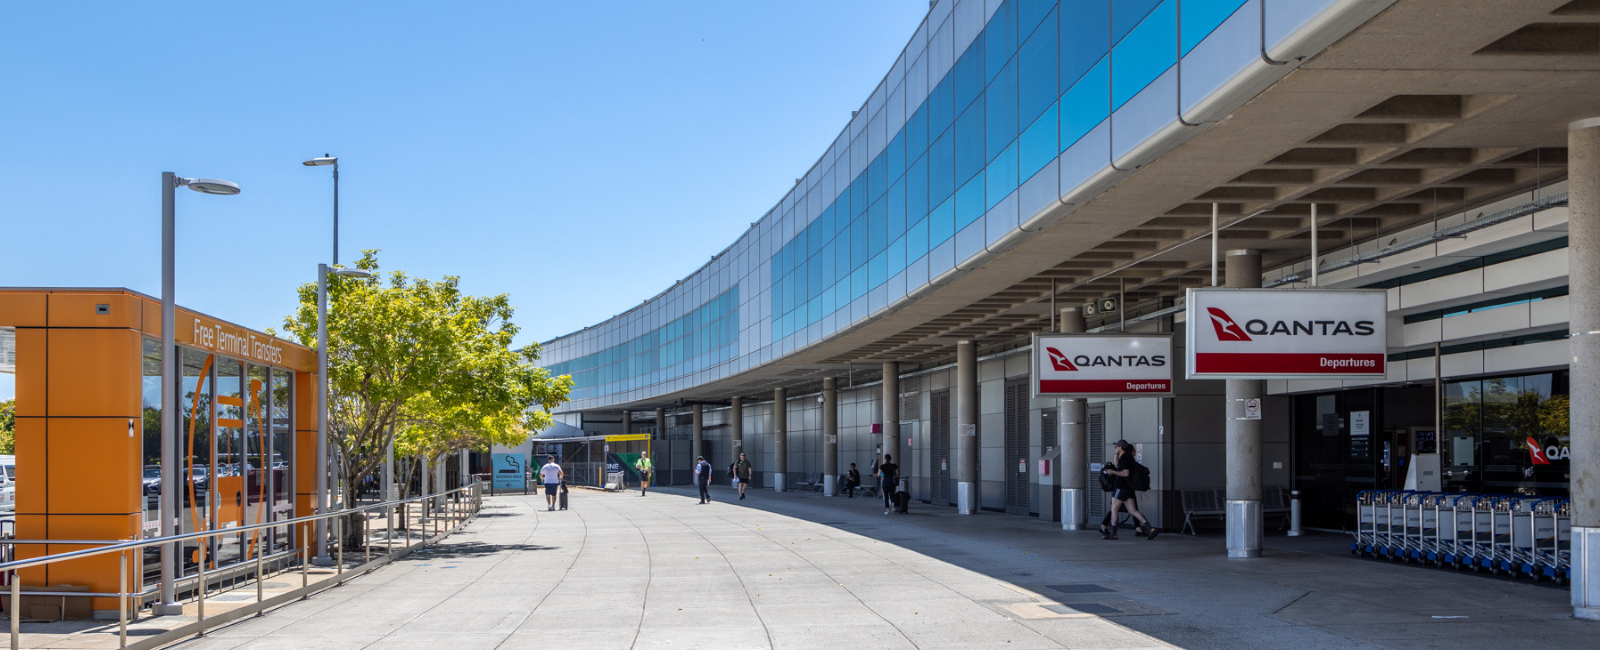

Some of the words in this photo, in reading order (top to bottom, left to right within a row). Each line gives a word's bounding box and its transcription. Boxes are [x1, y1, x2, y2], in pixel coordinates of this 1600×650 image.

[1245, 318, 1375, 336] QANTAS
[194, 318, 214, 348] Free
[215, 324, 249, 357] Terminal
[250, 334, 282, 364] Transfers
[1073, 354, 1166, 367] QANTAS
[1319, 357, 1376, 369] Departures
[1126, 382, 1166, 391] Departures
